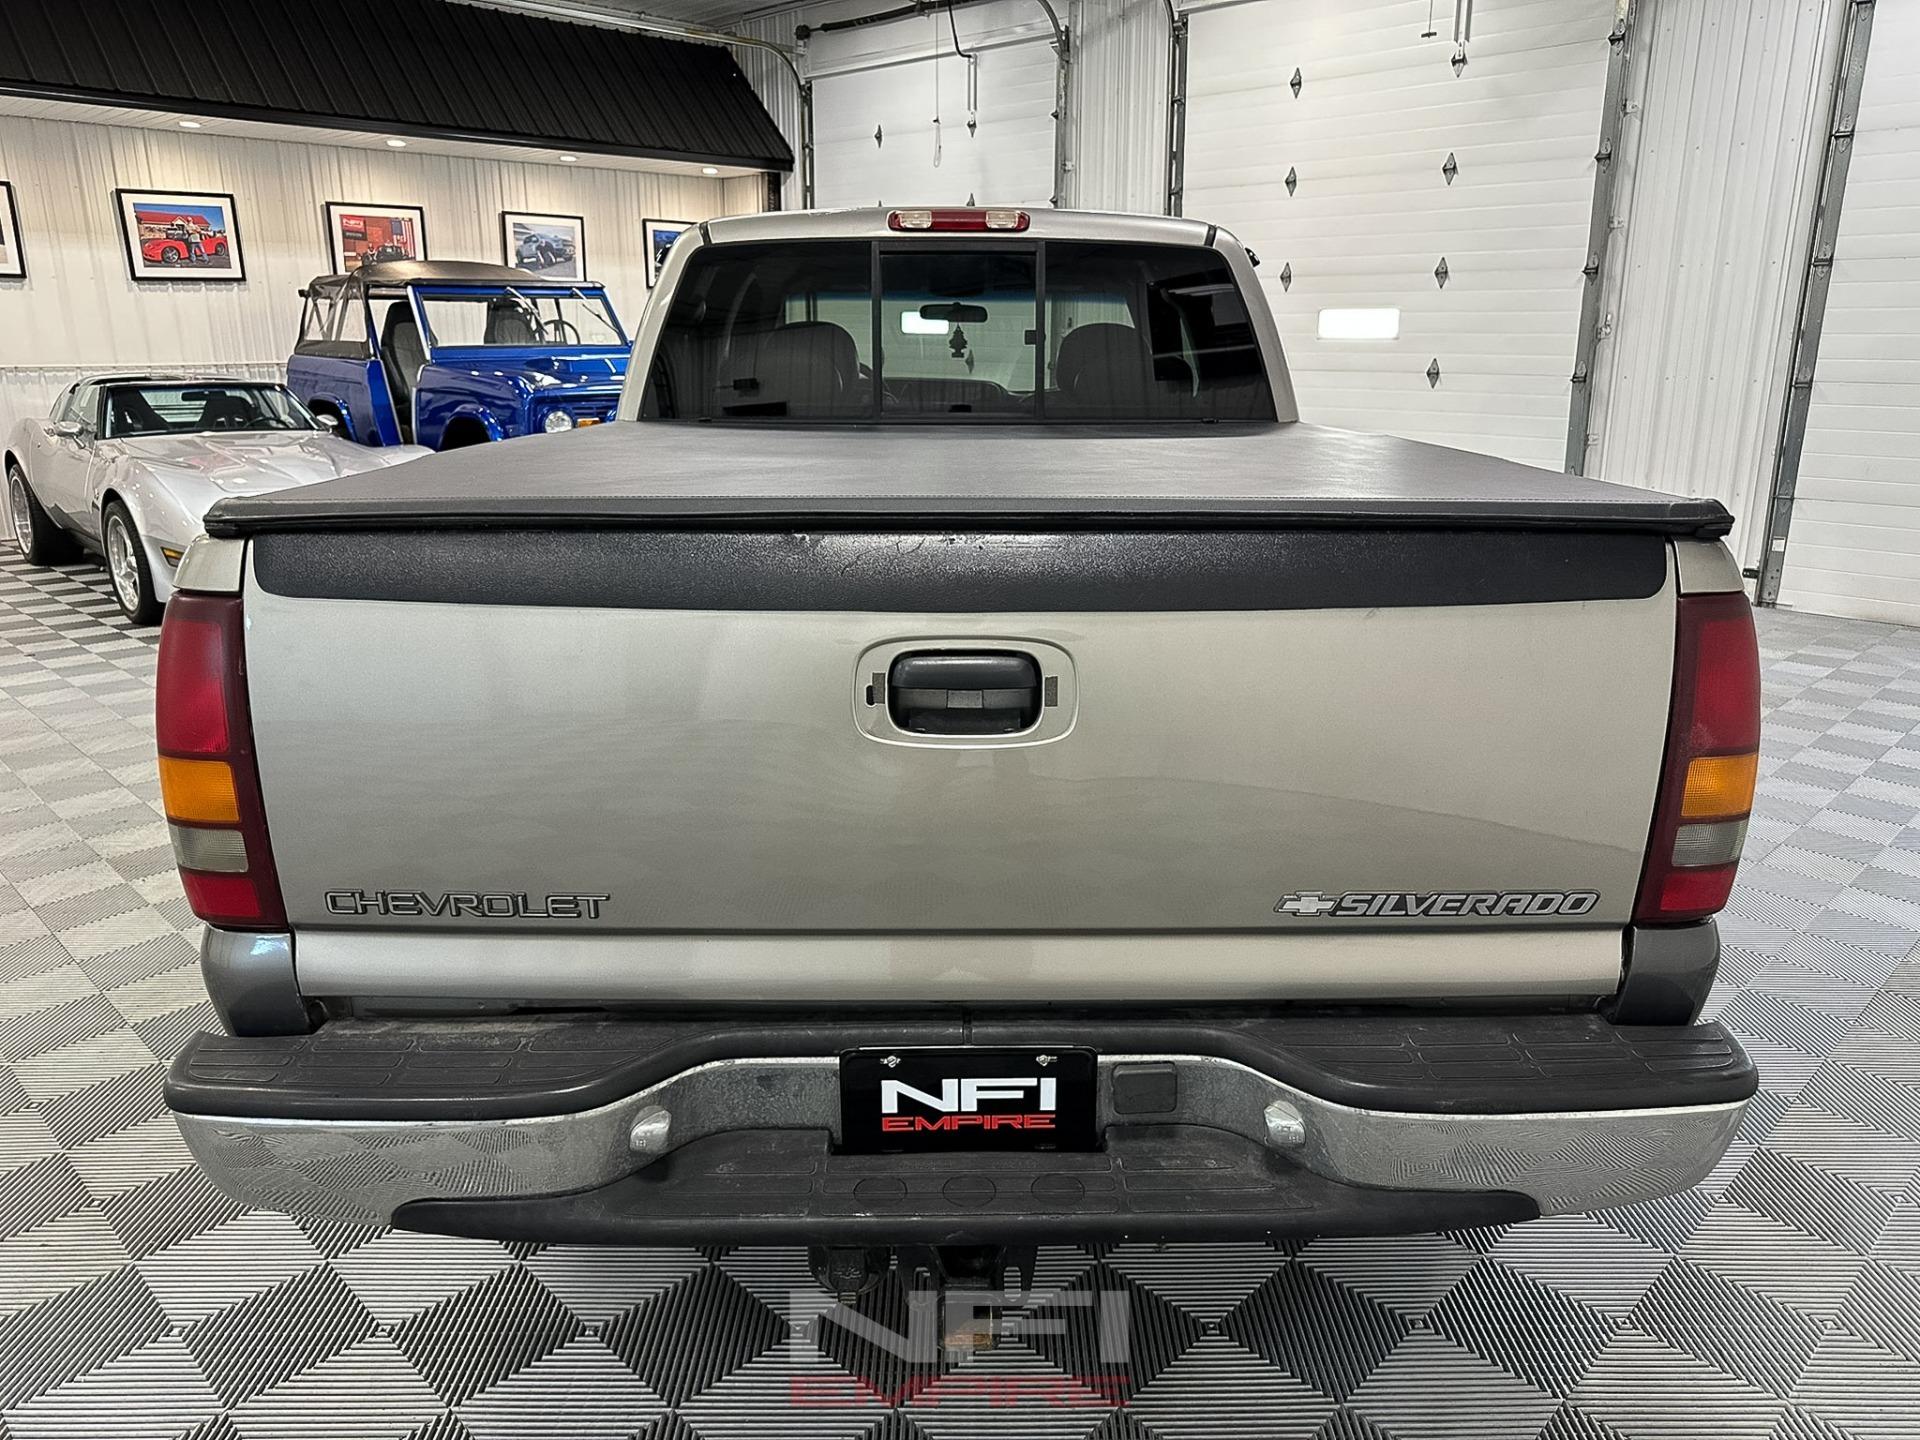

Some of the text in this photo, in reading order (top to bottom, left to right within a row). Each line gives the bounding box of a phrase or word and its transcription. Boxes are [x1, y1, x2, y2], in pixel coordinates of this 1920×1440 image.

[325, 889, 610, 918] CHEVROLET
[1330, 890, 1600, 917] SILVERADO
[881, 1078, 1056, 1113] NFI
[882, 1114, 1056, 1131] EMPIRE
